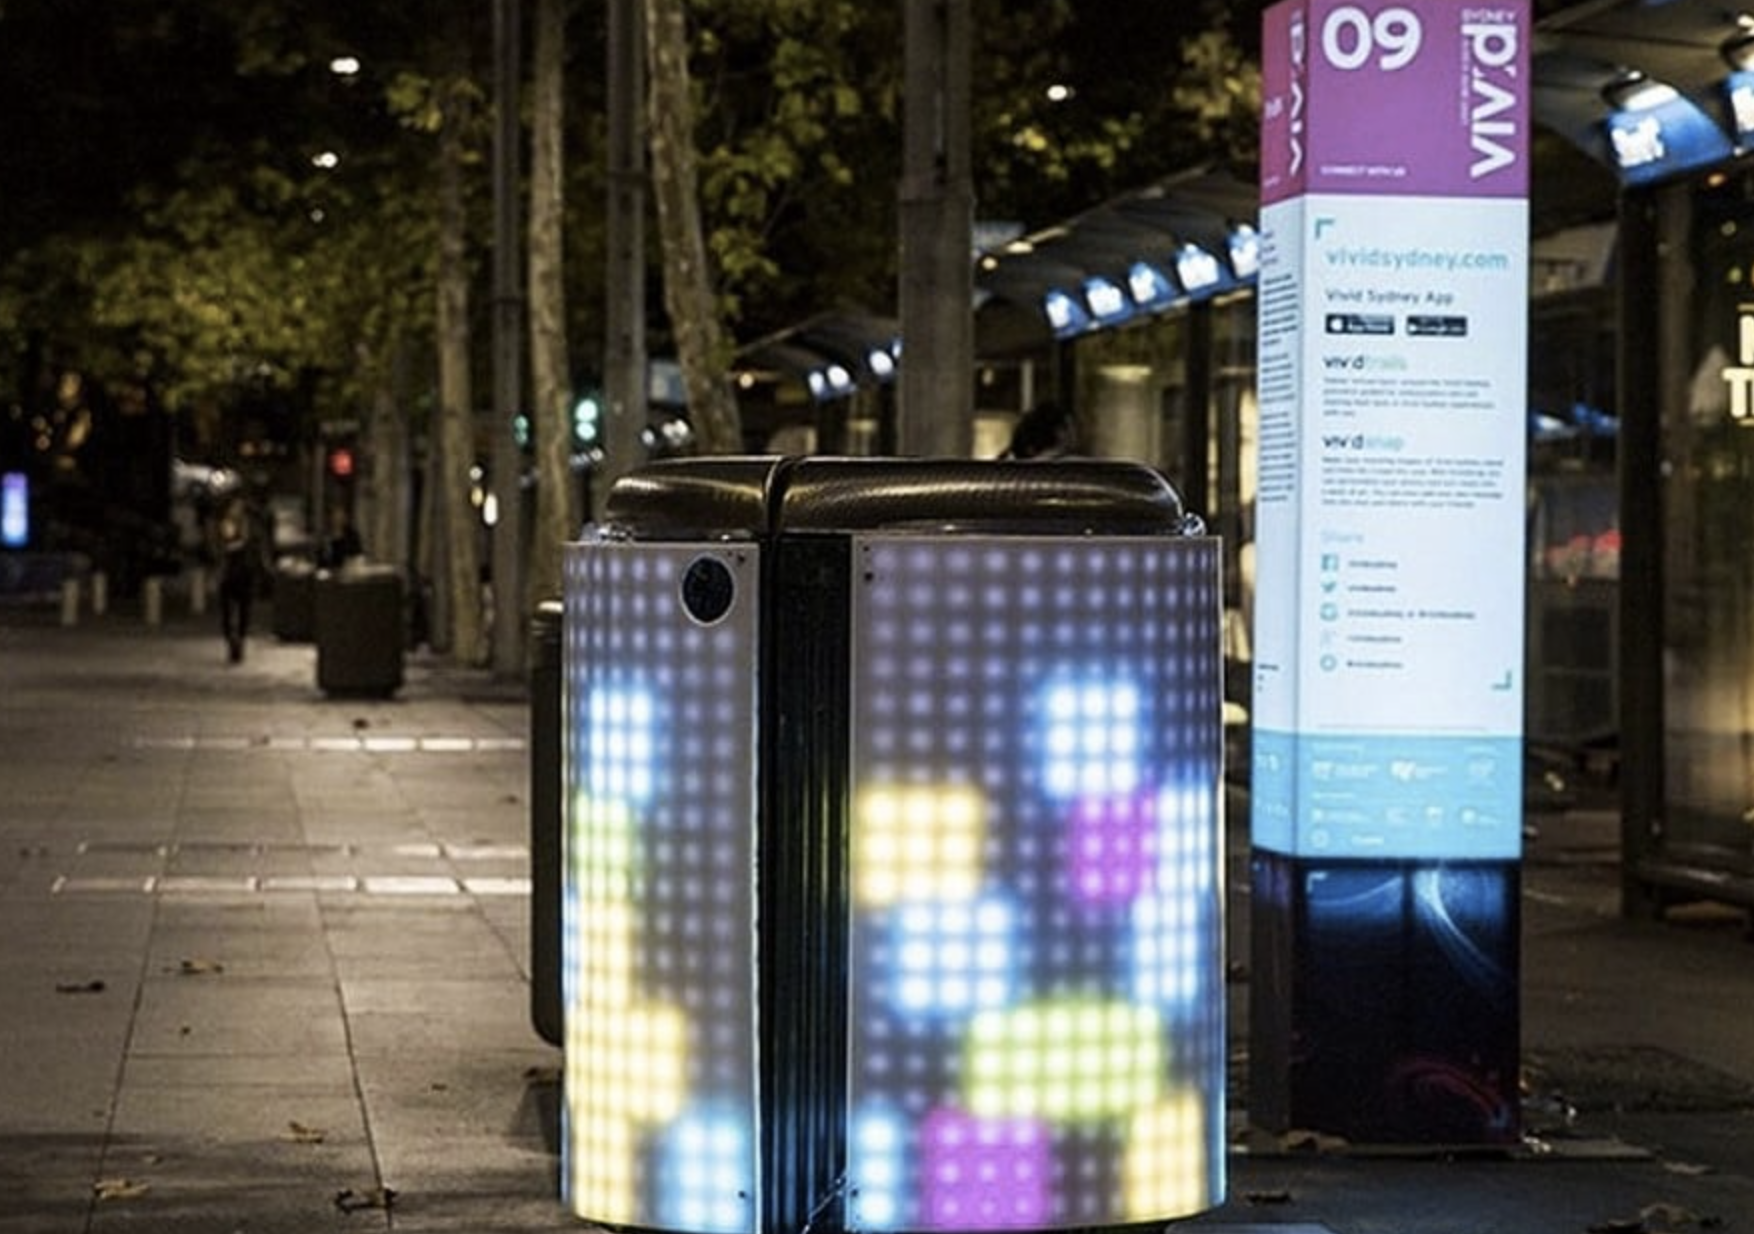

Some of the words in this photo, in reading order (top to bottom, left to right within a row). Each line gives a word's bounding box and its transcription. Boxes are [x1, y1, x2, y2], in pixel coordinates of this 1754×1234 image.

[1322, 6, 1422, 70] 09
[1325, 249, 1509, 270] vividsydney.com
[1326, 288, 1362, 302] Vivid
[1367, 289, 1419, 305] Sydney
[1426, 291, 1454, 305] App
